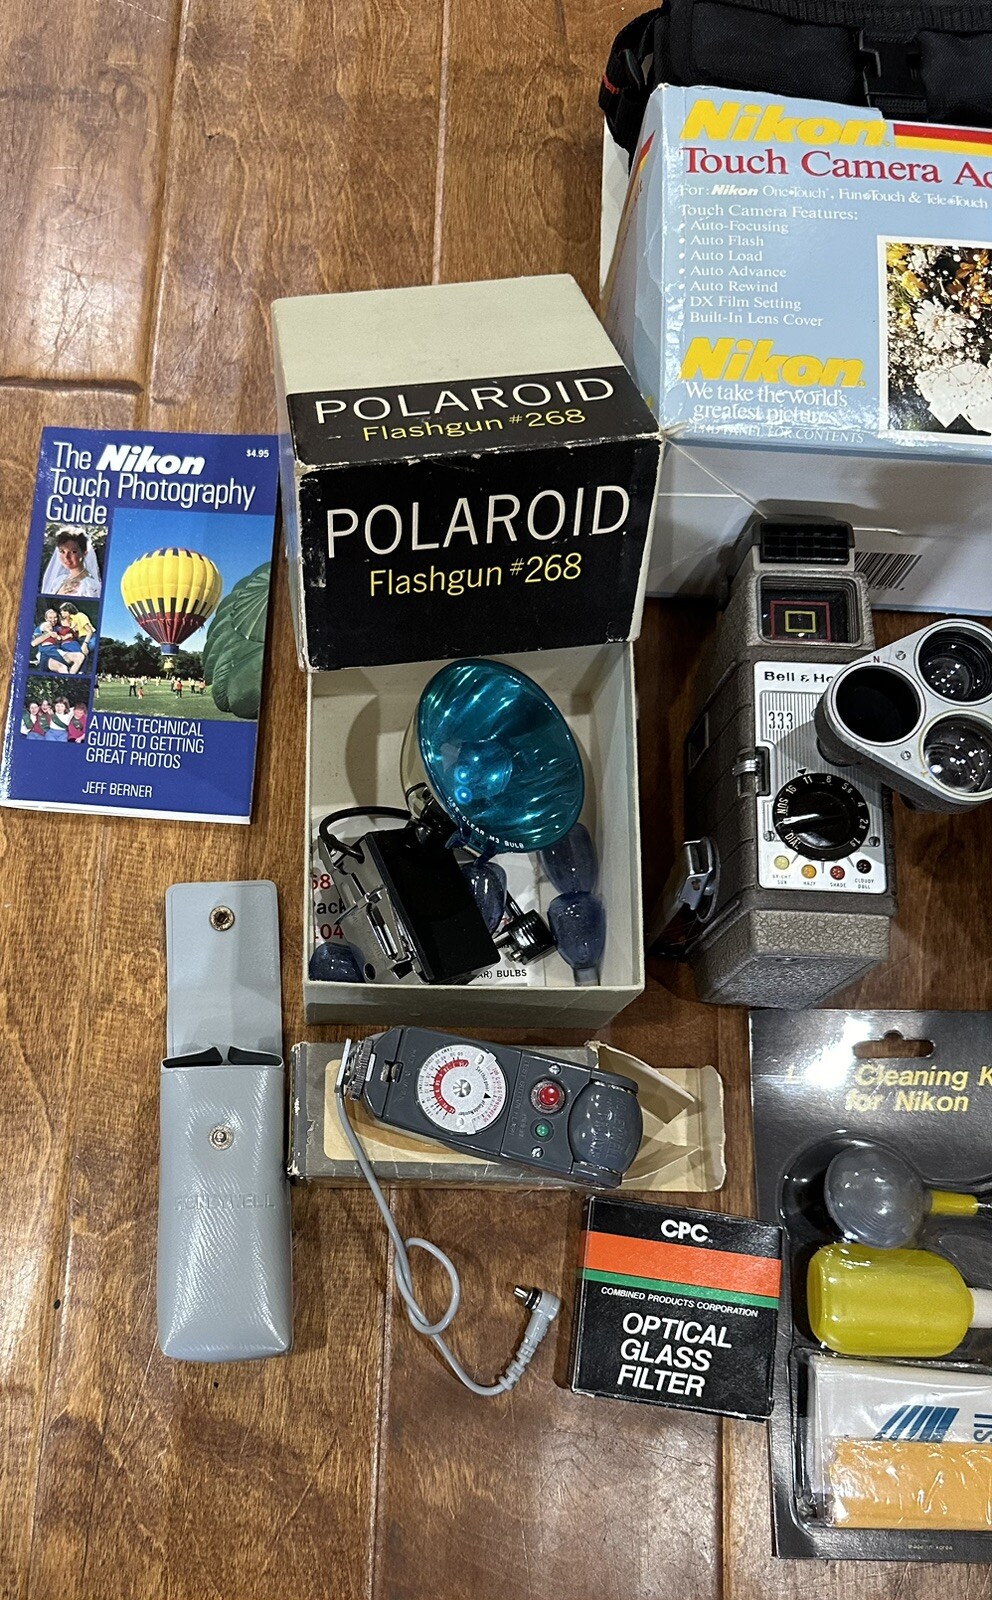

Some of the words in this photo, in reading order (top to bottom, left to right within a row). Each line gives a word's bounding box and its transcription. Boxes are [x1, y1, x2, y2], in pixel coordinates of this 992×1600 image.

[680, 98, 888, 147] Nikon
[680, 146, 789, 176] Touch
[801, 150, 942, 184] Camera
[711, 184, 758, 197] Nikon
[908, 192, 921, 205] &
[679, 203, 724, 218] Touch
[728, 205, 787, 219] Camera
[792, 206, 858, 221] Features:
[690, 220, 789, 234] Auto-Focusing
[690, 235, 724, 247] Auto
[728, 235, 764, 248] Flash
[690, 250, 724, 262] Auto
[728, 250, 763, 262] Load
[690, 265, 724, 277] Auto
[728, 266, 787, 278] Advance
[690, 281, 724, 292] Auto
[728, 281, 778, 293] Rewind
[690, 295, 714, 307] DX
[718, 295, 749, 308] Film
[753, 296, 801, 312] Setting
[690, 311, 742, 324] Built-In
[748, 312, 779, 325] Lens
[783, 313, 824, 327] Cover
[679, 336, 866, 388] Nikon
[314, 377, 615, 425] POLAROID
[685, 381, 713, 399] We
[717, 383, 753, 402] take
[757, 385, 788, 404] the
[362, 416, 504, 442] Flashgun
[508, 409, 587, 428] #268
[795, 428, 864, 444] CONTENTS
[53, 441, 92, 470] The
[95, 444, 206, 476] Nikon
[246, 449, 270, 458] $4.95
[50, 468, 110, 498] Touch
[118, 472, 256, 511] Photography
[45, 494, 107, 525] Guide
[326, 484, 631, 559] POLAROID
[369, 564, 503, 597] Flashgun
[510, 552, 583, 584] #268
[764, 670, 795, 682] Bell
[800, 674, 810, 683] &
[89, 716, 99, 730] A
[102, 717, 204, 737] NON-TECHNICAL
[768, 711, 794, 730] 333
[87, 731, 126, 749] GUIDE
[130, 734, 146, 750] TO
[150, 736, 205, 754] GETTING
[86, 747, 128, 765] GREAT
[130, 750, 182, 769] PHOTOS
[82, 781, 107, 795] JEFF
[109, 782, 153, 798] BERNER
[461, 815, 485, 836] CLEAR
[504, 840, 525, 849] BULB
[313, 897, 347, 914] ack
[314, 923, 345, 940] 04
[496, 968, 527, 978] BULBS
[853, 1063, 969, 1092] Cleaning
[845, 1088, 885, 1112] for
[893, 1090, 970, 1112] Nikon
[660, 1218, 709, 1243] CPC
[601, 1286, 646, 1300] COMBINED
[647, 1294, 695, 1308] PRODUCTS
[697, 1301, 758, 1318] CORPORATION
[622, 1312, 732, 1349] OPTICAL
[620, 1338, 713, 1371] GLASS
[616, 1364, 706, 1397] FILTER
